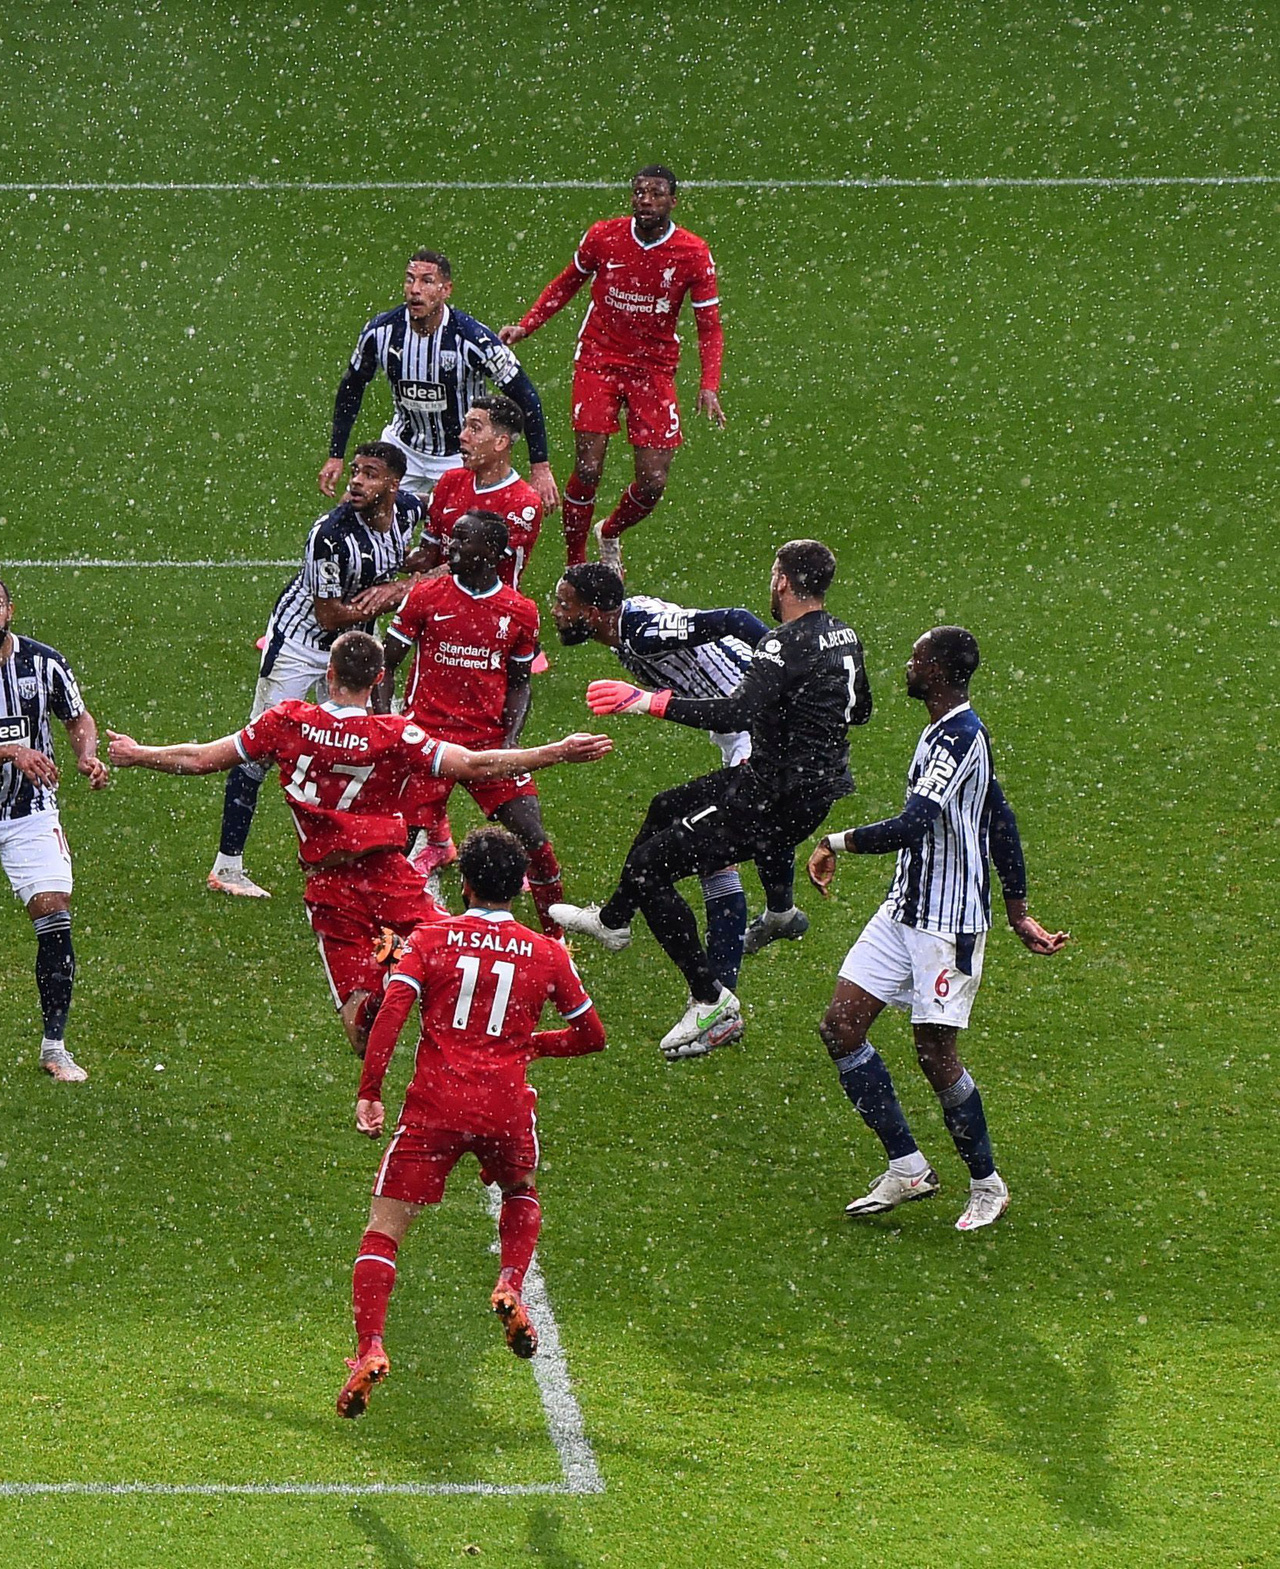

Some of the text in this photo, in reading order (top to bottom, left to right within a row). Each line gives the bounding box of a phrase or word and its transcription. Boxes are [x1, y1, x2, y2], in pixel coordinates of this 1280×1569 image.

[608, 286, 655, 303] Standard
[604, 295, 653, 314] Chartered
[402, 383, 441, 400] ideal
[668, 402, 680, 430] 5
[439, 641, 490, 658] Standard
[754, 649, 785, 668] Expedia
[433, 652, 488, 670] Chartered
[842, 655, 857, 723] 1
[301, 723, 369, 752] PHILLIPS
[923, 759, 954, 784] 12
[284, 754, 376, 811] 47
[916, 777, 946, 793] BET
[690, 805, 718, 824] 1
[934, 968, 950, 997] 6
[452, 955, 516, 1037] 11
